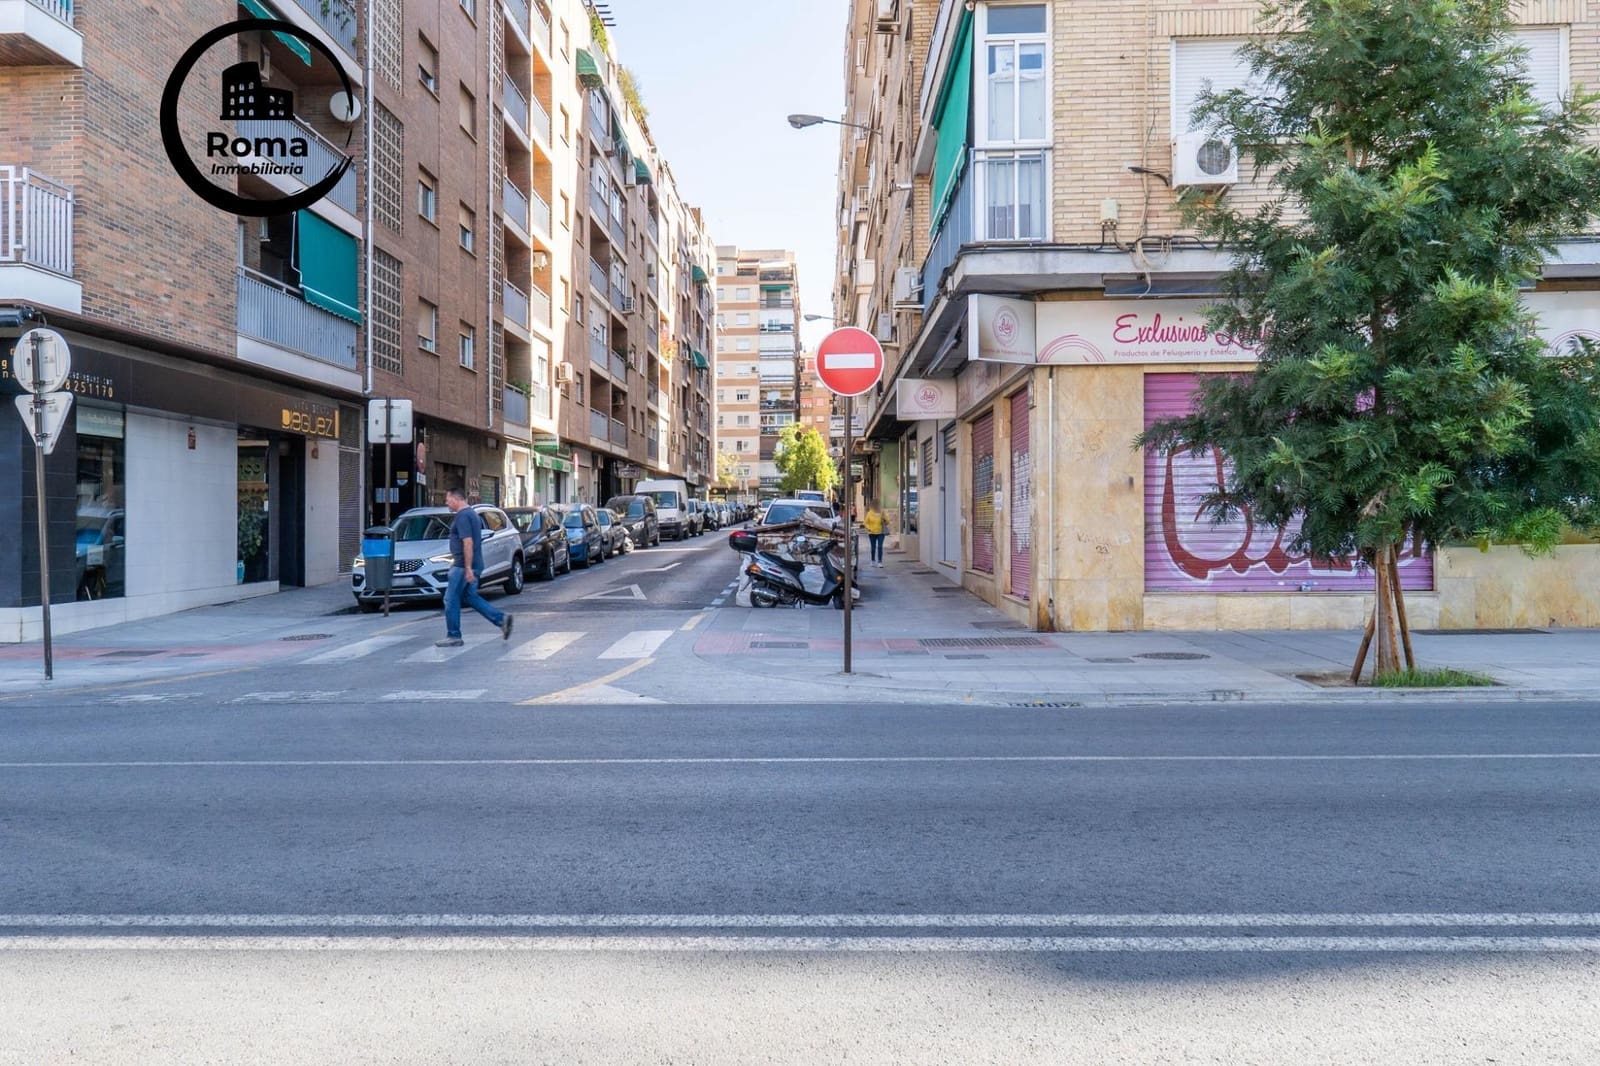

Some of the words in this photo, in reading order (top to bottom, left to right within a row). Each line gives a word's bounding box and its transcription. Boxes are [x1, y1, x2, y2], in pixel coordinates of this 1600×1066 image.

[1113, 313, 1208, 344] Exclusivas
[1113, 349, 1149, 357] Productos
[1151, 349, 1160, 357] de
